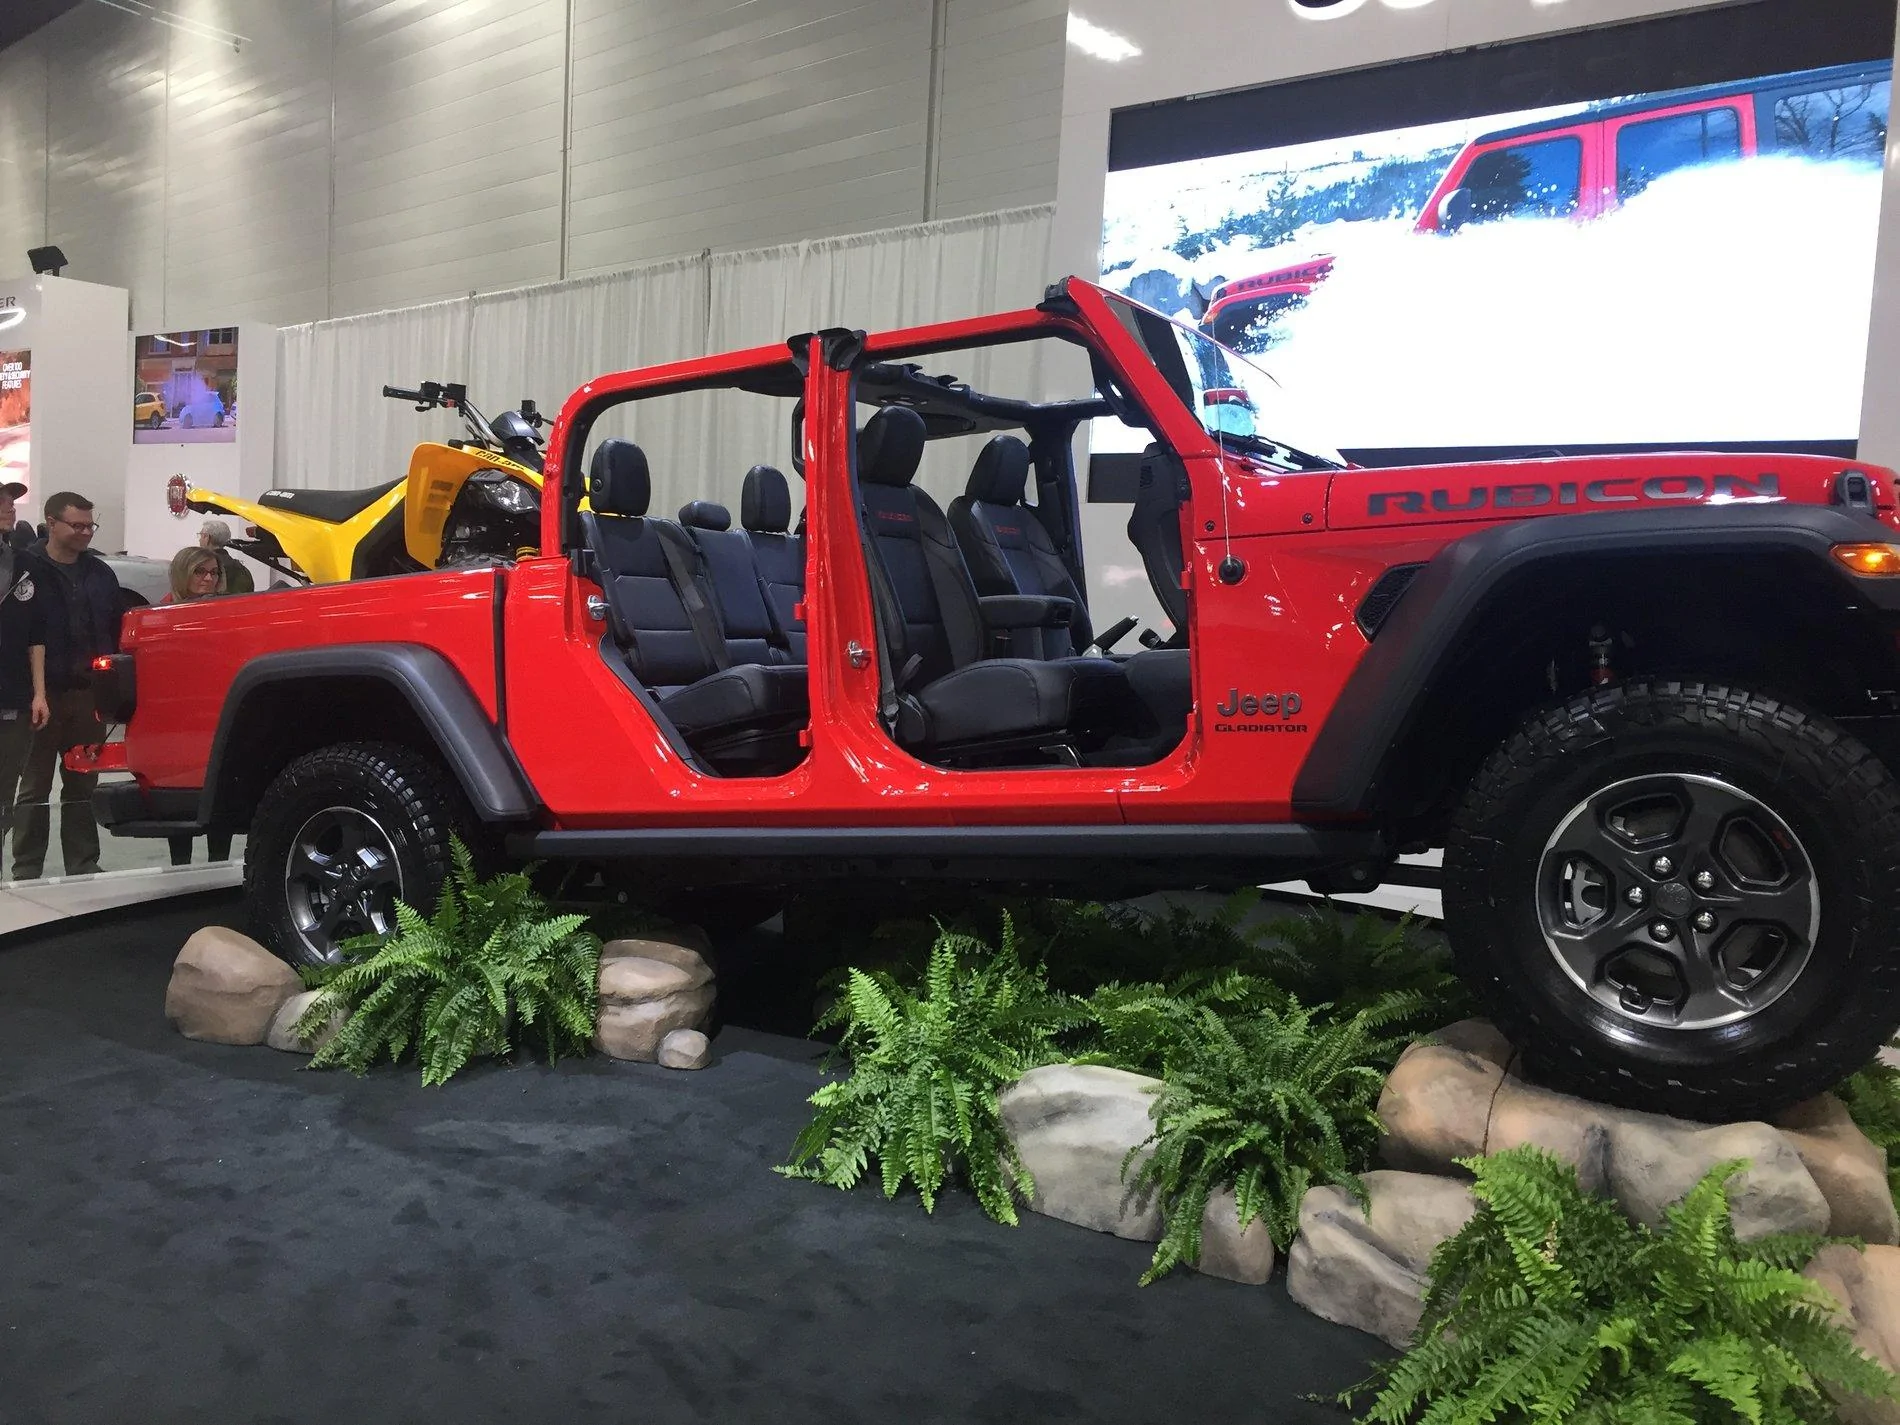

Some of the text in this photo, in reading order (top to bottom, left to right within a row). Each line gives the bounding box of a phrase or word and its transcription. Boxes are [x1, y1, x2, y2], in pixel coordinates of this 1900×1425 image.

[2, 379, 22, 389] FEATURES
[1367, 473, 1781, 516] RUBICON
[1216, 687, 1303, 720] Jeep
[1214, 723, 1309, 733] GLADIATOR
